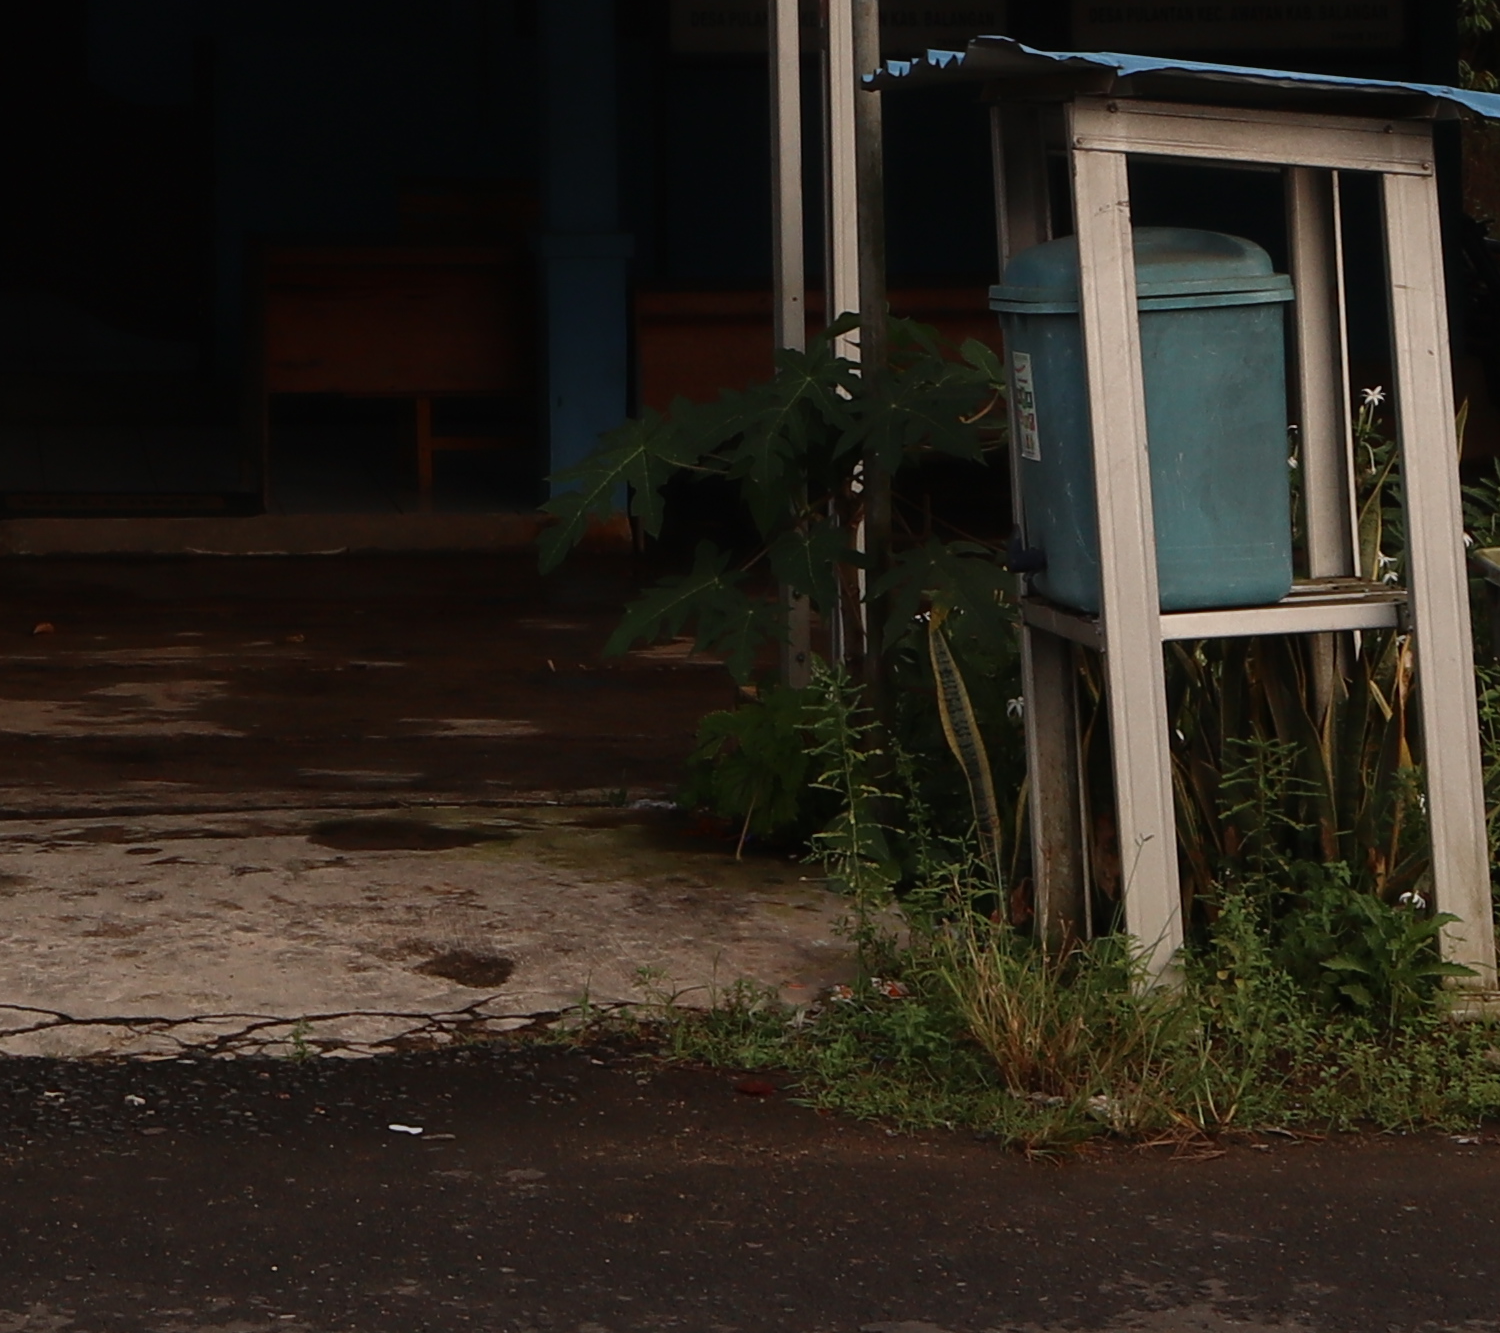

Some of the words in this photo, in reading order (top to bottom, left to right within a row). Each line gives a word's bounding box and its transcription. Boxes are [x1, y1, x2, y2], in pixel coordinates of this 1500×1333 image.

[924, 10, 994, 27] BALANGAN
[1088, 6, 1123, 24] DESA
[1127, 6, 1195, 23] PULANTAN
